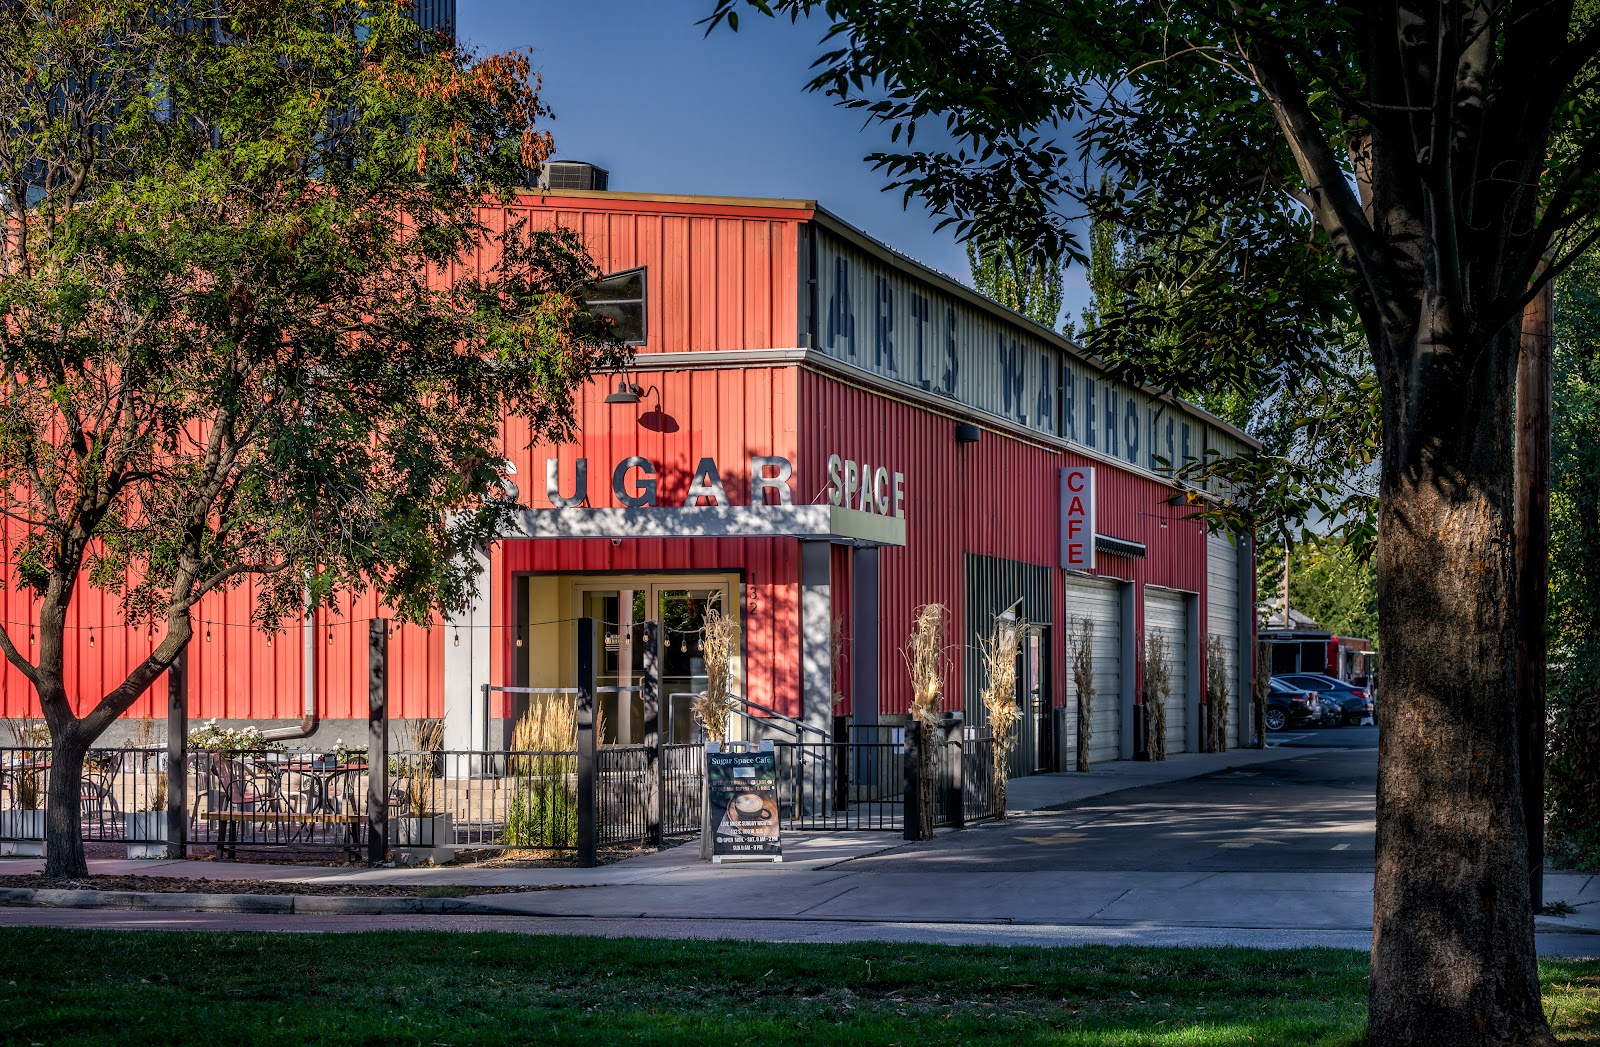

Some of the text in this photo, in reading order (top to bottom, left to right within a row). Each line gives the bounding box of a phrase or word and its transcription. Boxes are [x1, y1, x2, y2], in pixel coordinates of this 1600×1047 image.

[827, 257, 1189, 482] ARTS WAREHOUSE
[827, 454, 906, 519] SPACE
[1067, 471, 1085, 564] CAFE
[711, 757, 732, 765] Sugar
[733, 757, 754, 765] Space
